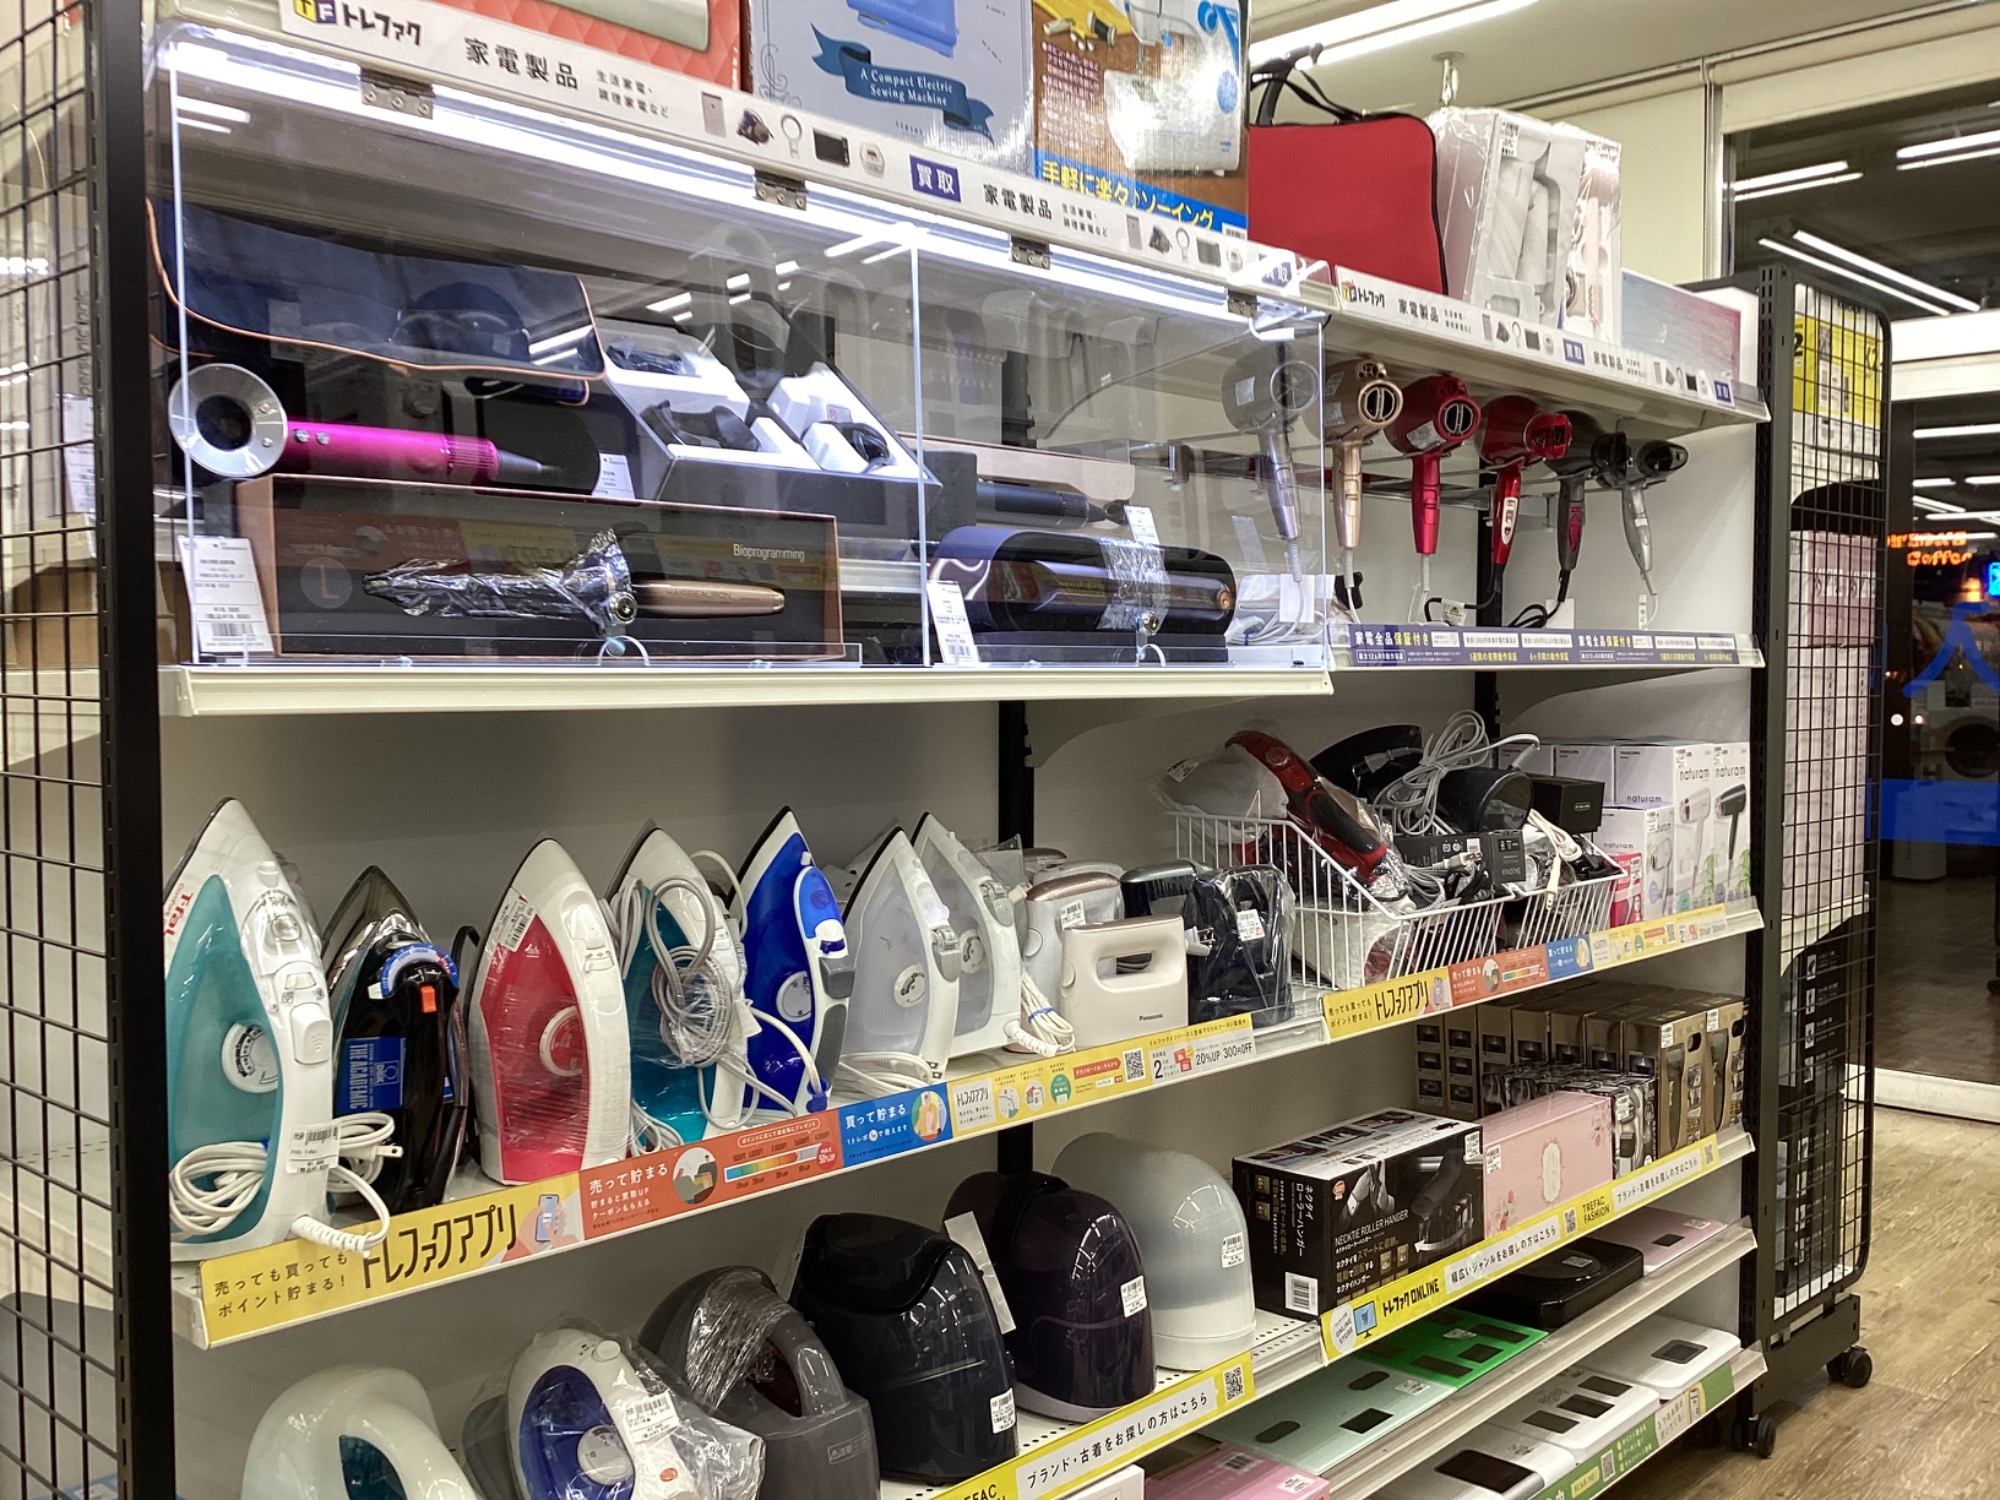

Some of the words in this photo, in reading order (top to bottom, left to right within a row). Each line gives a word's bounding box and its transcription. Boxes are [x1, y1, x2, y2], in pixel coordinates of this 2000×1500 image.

[343, 4, 421, 46] トレファク
[464, 37, 578, 90] 家電製品
[860, 67, 869, 80] A
[871, 70, 914, 88] Compact
[917, 76, 953, 93] Electric
[870, 84, 905, 103] Sewing
[907, 89, 947, 106] Machine
[917, 163, 955, 195] 買取
[983, 184, 1052, 220] 家電製品
[1358, 287, 1385, 308] トレファク
[1398, 299, 1439, 322] 家電製品
[733, 543, 805, 562] Bioprogramming
[321, 564, 339, 599] L
[1680, 768, 1709, 780] naturam
[1716, 765, 1746, 778] naturam
[1627, 795, 1662, 803] naturam
[1452, 966, 1481, 980] 売って貯まる
[1328, 998, 1372, 1016] 売っても買っても
[1374, 980, 1429, 1021] トレファクアプリ
[1139, 1013, 1163, 1021] Panasonic
[349, 1044, 368, 1060] THE
[1195, 1050, 1221, 1066] 20%UP
[1154, 1060, 1163, 1079] 2
[349, 1061, 368, 1109] ACADEMIC
[956, 1087, 989, 1107] トレファクアプリ
[845, 1104, 906, 1129] 買って貯まる
[589, 1163, 668, 1195] 売って貯まる
[591, 1187, 649, 1209] 貯まると買取UP
[592, 1198, 650, 1220] クーポンもらえる
[1305, 1184, 1314, 1220] ネクタイ
[1582, 1196, 1604, 1213] TREFAC
[1296, 1183, 1306, 1257] ローラーハンガー
[1584, 1205, 1610, 1223] FASHION
[1335, 1228, 1360, 1247] NECKTIE
[1361, 1219, 1384, 1237] ROLLER
[1384, 1209, 1409, 1227] HANGER
[362, 1204, 517, 1289] トレファクアプリ
[214, 1252, 348, 1298] 売っても買っても
[1383, 1293, 1409, 1317] トレファク
[1411, 1279, 1439, 1302] ONLINE
[1336, 1318, 1352, 1338] ONLINE
[1339, 1328, 1354, 1345] STORE
[1027, 1392, 1207, 1488] ブランド・古着をお探しの方はこちら
